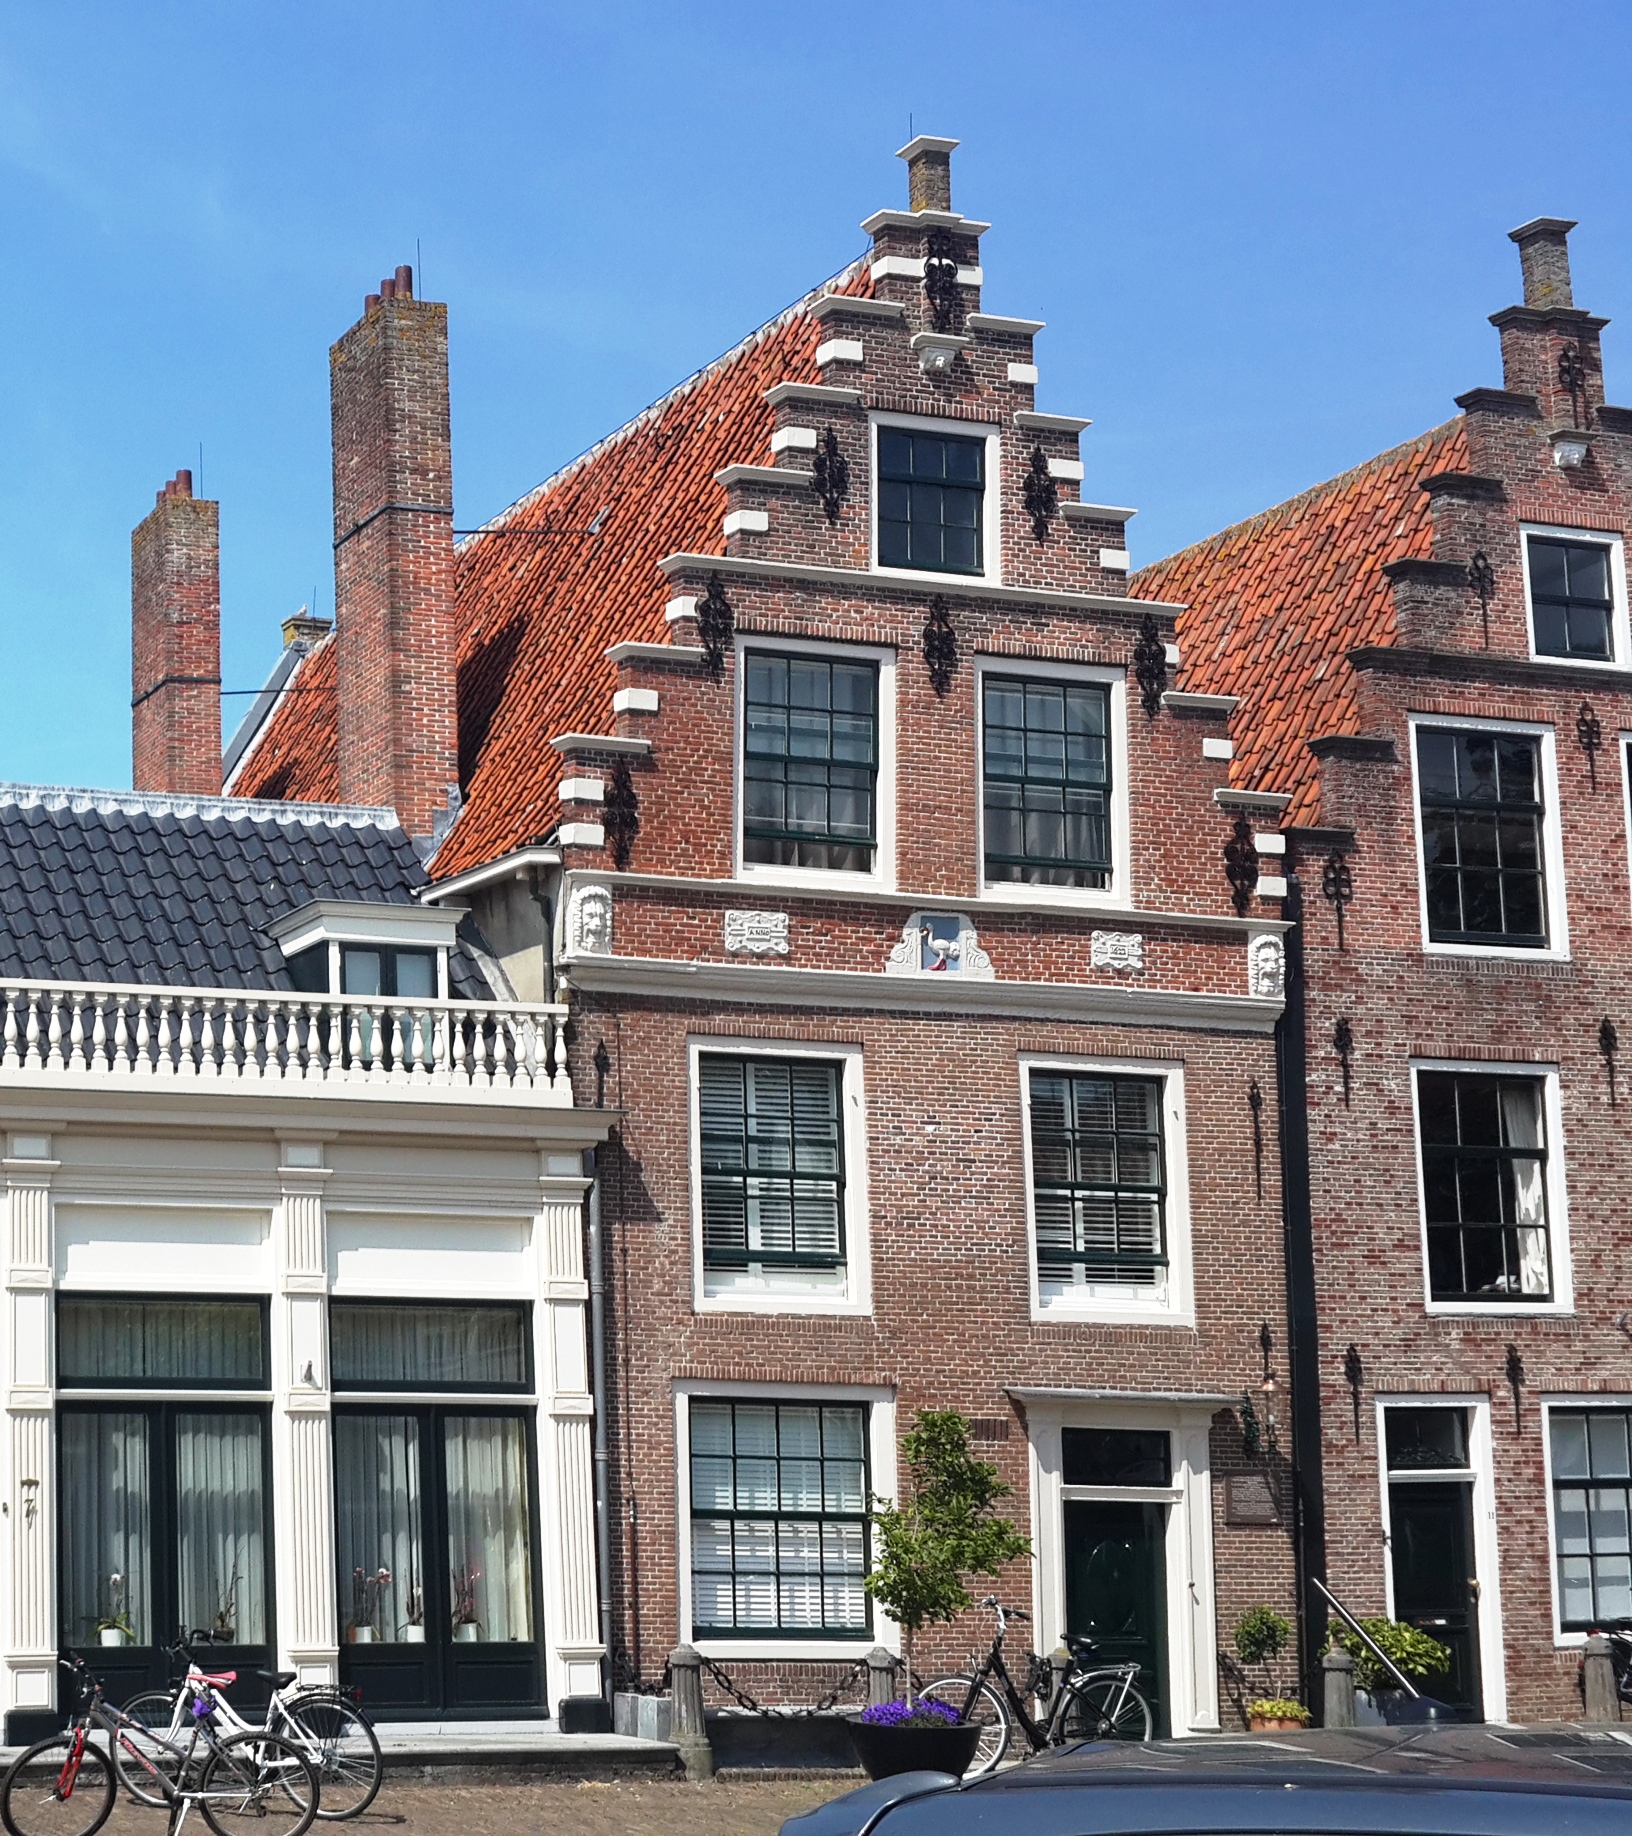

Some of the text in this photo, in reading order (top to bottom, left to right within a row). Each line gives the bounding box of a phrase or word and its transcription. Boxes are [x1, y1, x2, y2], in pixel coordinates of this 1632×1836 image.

[748, 927, 770, 937] ANNO
[23, 1498, 35, 1518] 7
[1487, 1511, 1495, 1520] 11
